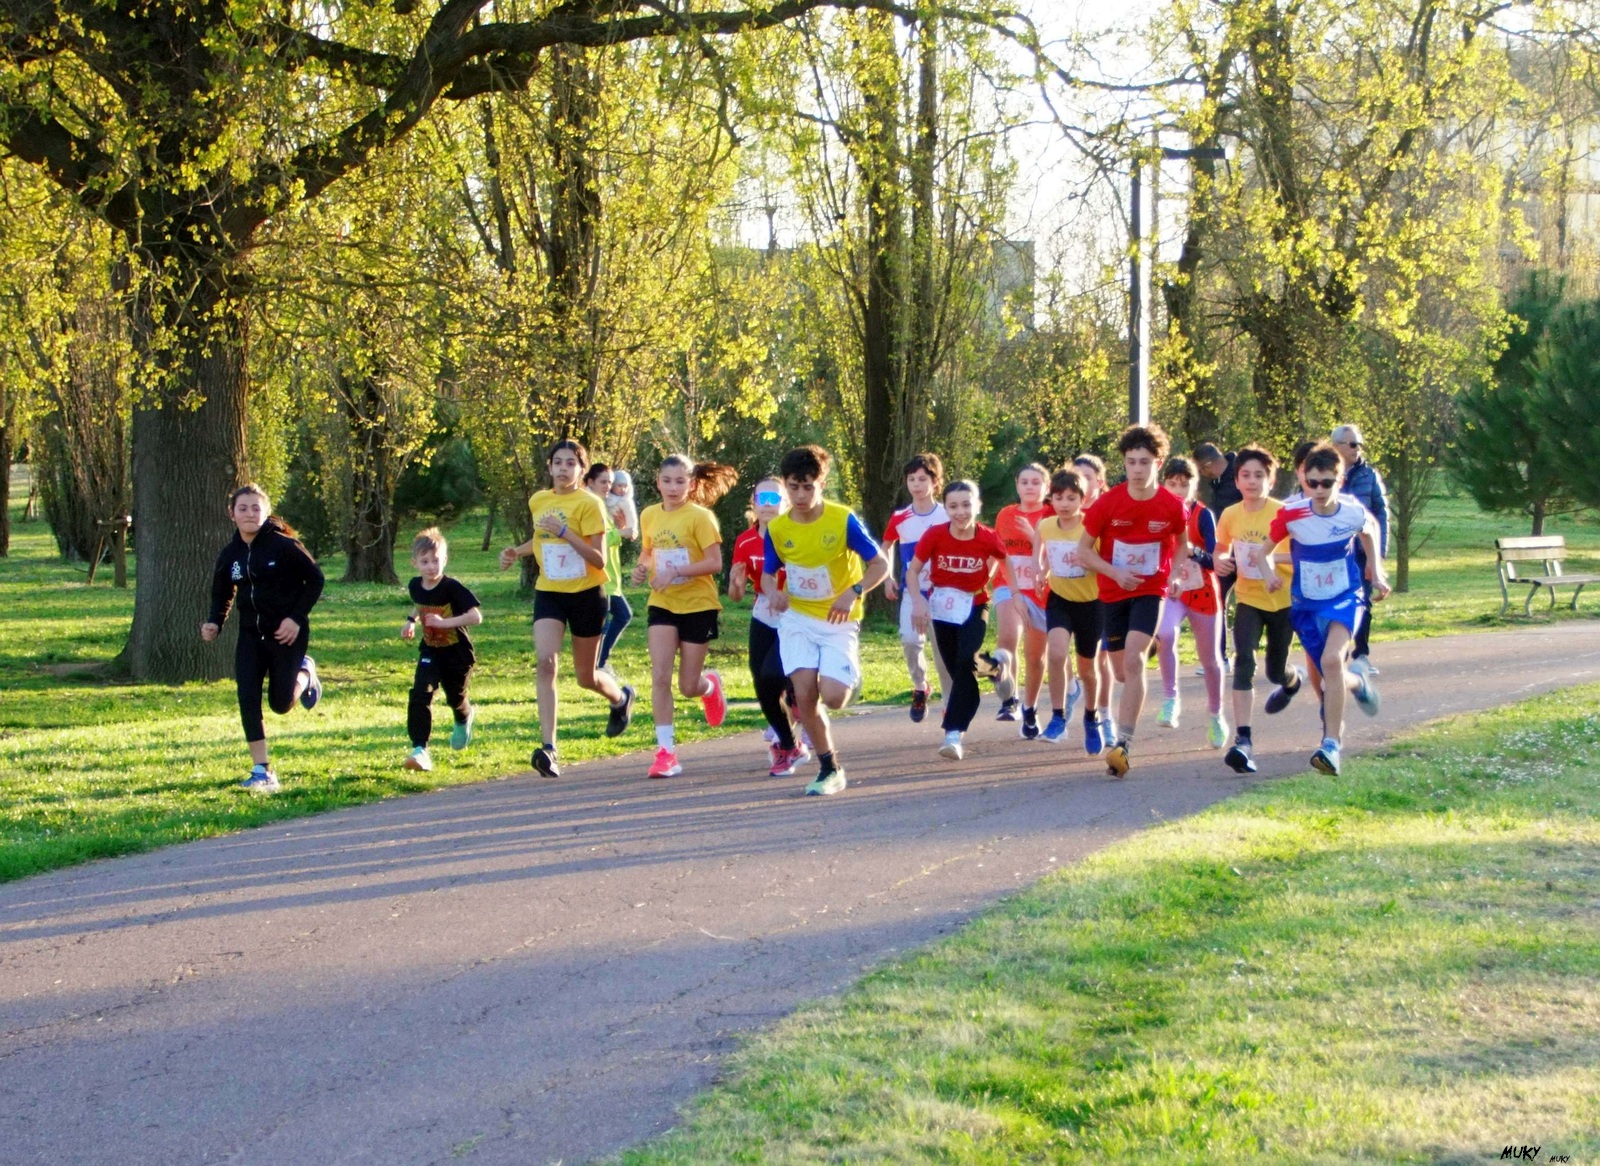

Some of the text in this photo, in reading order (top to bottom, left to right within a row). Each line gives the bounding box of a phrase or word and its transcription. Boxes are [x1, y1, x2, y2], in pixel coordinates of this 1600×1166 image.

[557, 554, 567, 568] 7
[1126, 553, 1147, 566] 24
[1015, 565, 1032, 579] 16
[798, 576, 818, 591] 26
[1314, 572, 1335, 589] 14
[944, 597, 955, 611] 8
